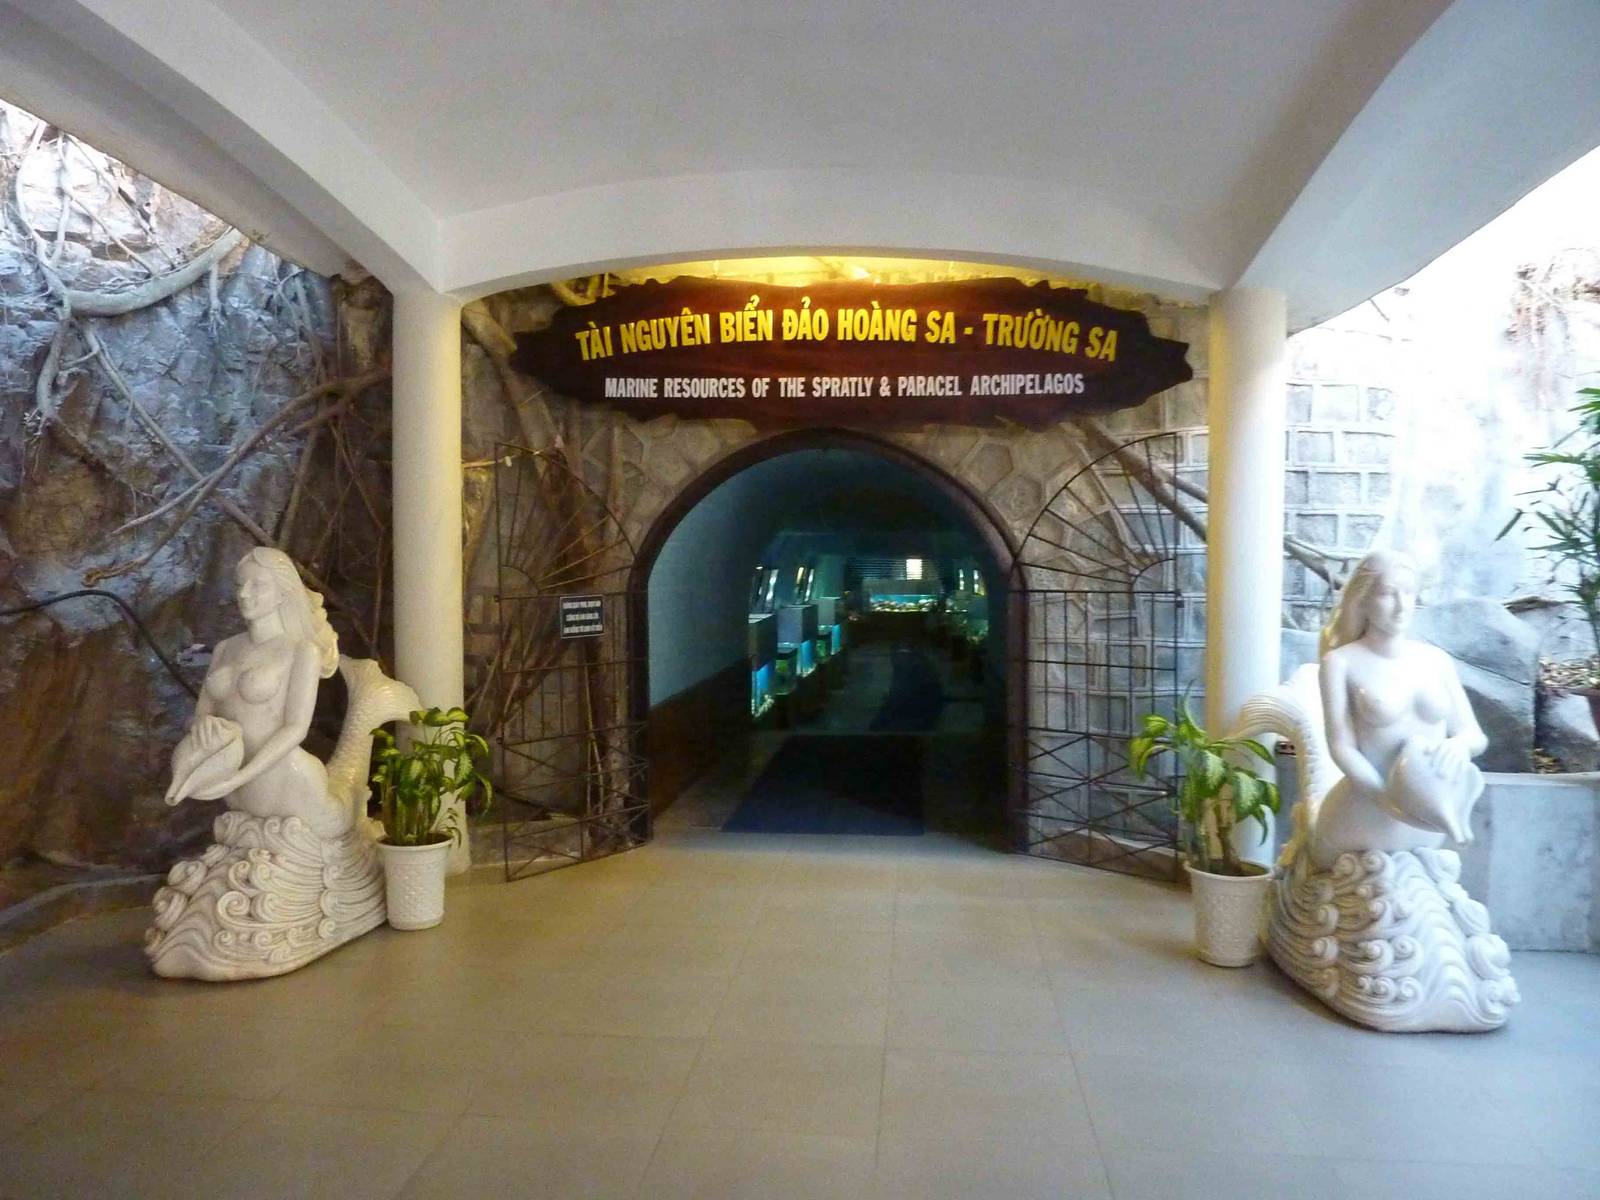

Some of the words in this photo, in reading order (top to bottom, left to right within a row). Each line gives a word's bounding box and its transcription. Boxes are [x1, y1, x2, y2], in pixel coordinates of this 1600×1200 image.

[575, 320, 614, 361] TÀI
[620, 307, 711, 354] NGUYÊN
[720, 295, 773, 343] BIỂN
[782, 296, 829, 341] ĐẢO
[837, 301, 917, 342] HOÀNG
[925, 310, 956, 344] SA
[963, 326, 974, 335] -
[983, 308, 1080, 354] TRƯỜNG
[1085, 326, 1118, 362] SA
[605, 377, 658, 398] MARINE
[664, 377, 746, 398] RESOURCES
[752, 377, 770, 398] OF
[778, 377, 805, 398] THE
[812, 376, 873, 397] SPRATLY
[880, 376, 891, 396] &
[898, 375, 962, 396] PARACEL
[970, 373, 1085, 396] ARCHIPELAGOS
